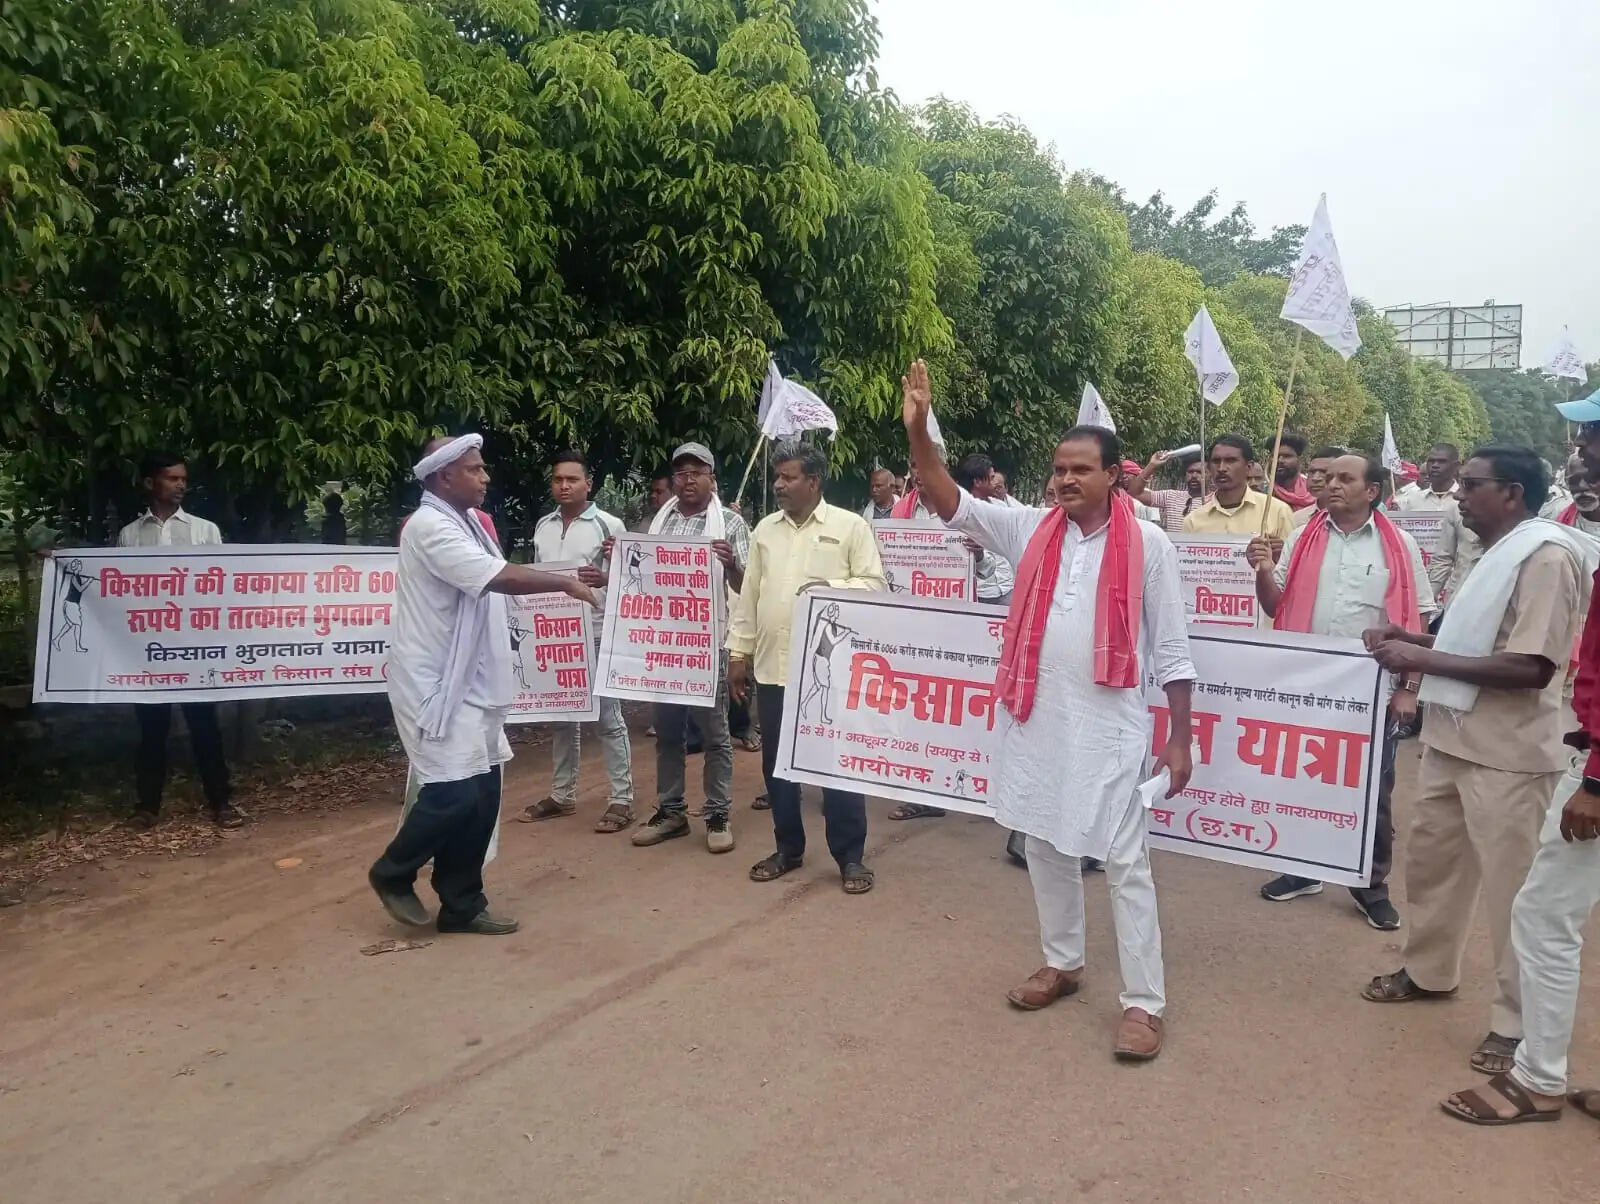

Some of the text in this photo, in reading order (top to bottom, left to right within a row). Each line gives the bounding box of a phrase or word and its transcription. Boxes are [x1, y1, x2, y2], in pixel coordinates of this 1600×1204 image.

[655, 546, 708, 567] किसानों की
[100, 567, 189, 597] किसानों
[194, 566, 226, 596] की
[233, 572, 308, 595] बकाया
[313, 565, 362, 594] राशि
[654, 569, 709, 589] बकाया राशि
[912, 570, 966, 598] किसान
[620, 589, 711, 630] 6066 करोड़
[1195, 586, 1255, 617] किसान
[189, 607, 222, 631] का
[227, 605, 308, 630] तत्काल
[313, 603, 393, 636] भुगतान
[534, 613, 582, 640] किसान
[145, 641, 227, 663] किसान
[235, 642, 325, 664] भुगतान
[658, 630, 673, 645] का
[676, 632, 712, 649] तत्काल
[535, 642, 584, 672] भुगतान
[645, 652, 684, 671] भुगतान
[106, 670, 190, 686] आयोजक
[220, 666, 265, 684] प्रदेश
[272, 664, 334, 682] किसान
[341, 663, 374, 680] संघ
[555, 668, 587, 689] यात्रा
[846, 652, 996, 731] किसान
[1206, 681, 1232, 697] समर्थन
[1278, 694, 1300, 709] कानून
[1303, 692, 1315, 707] की
[1316, 695, 1333, 709] मांग
[1335, 696, 1346, 711] को
[1347, 697, 1370, 714] लेकर
[814, 723, 825, 737] से
[968, 748, 981, 763] से
[1237, 717, 1371, 788] यात्रा
[838, 753, 934, 785] आयोजक
[1185, 808, 1278, 852] (छ.ग.)
[1276, 803, 1357, 830] नारायणपुर)
